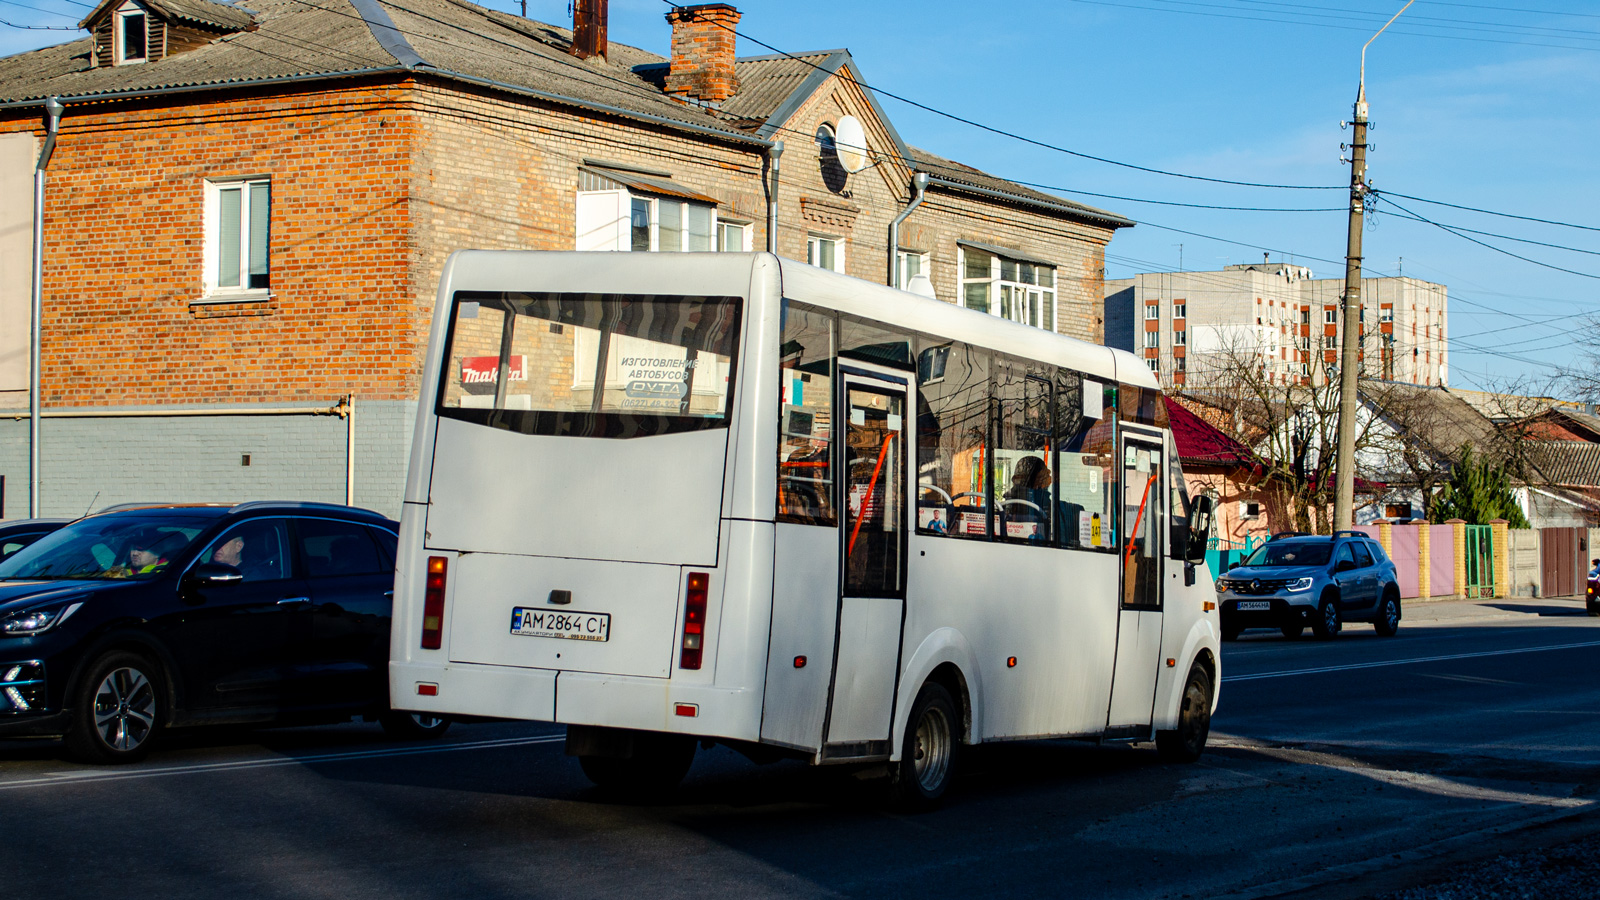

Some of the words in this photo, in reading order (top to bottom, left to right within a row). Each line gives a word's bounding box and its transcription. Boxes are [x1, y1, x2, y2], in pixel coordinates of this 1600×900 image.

[620, 357, 699, 369] ИЗГОТОВЛЕНИЕ
[462, 367, 522, 384] Makta
[628, 369, 689, 381] АВТОБУСОВ
[631, 382, 680, 394] РУТА
[620, 398, 648, 409] (0627)
[1091, 525, 1101, 537] 147
[522, 612, 544, 629] AM
[546, 614, 581, 632] 2864
